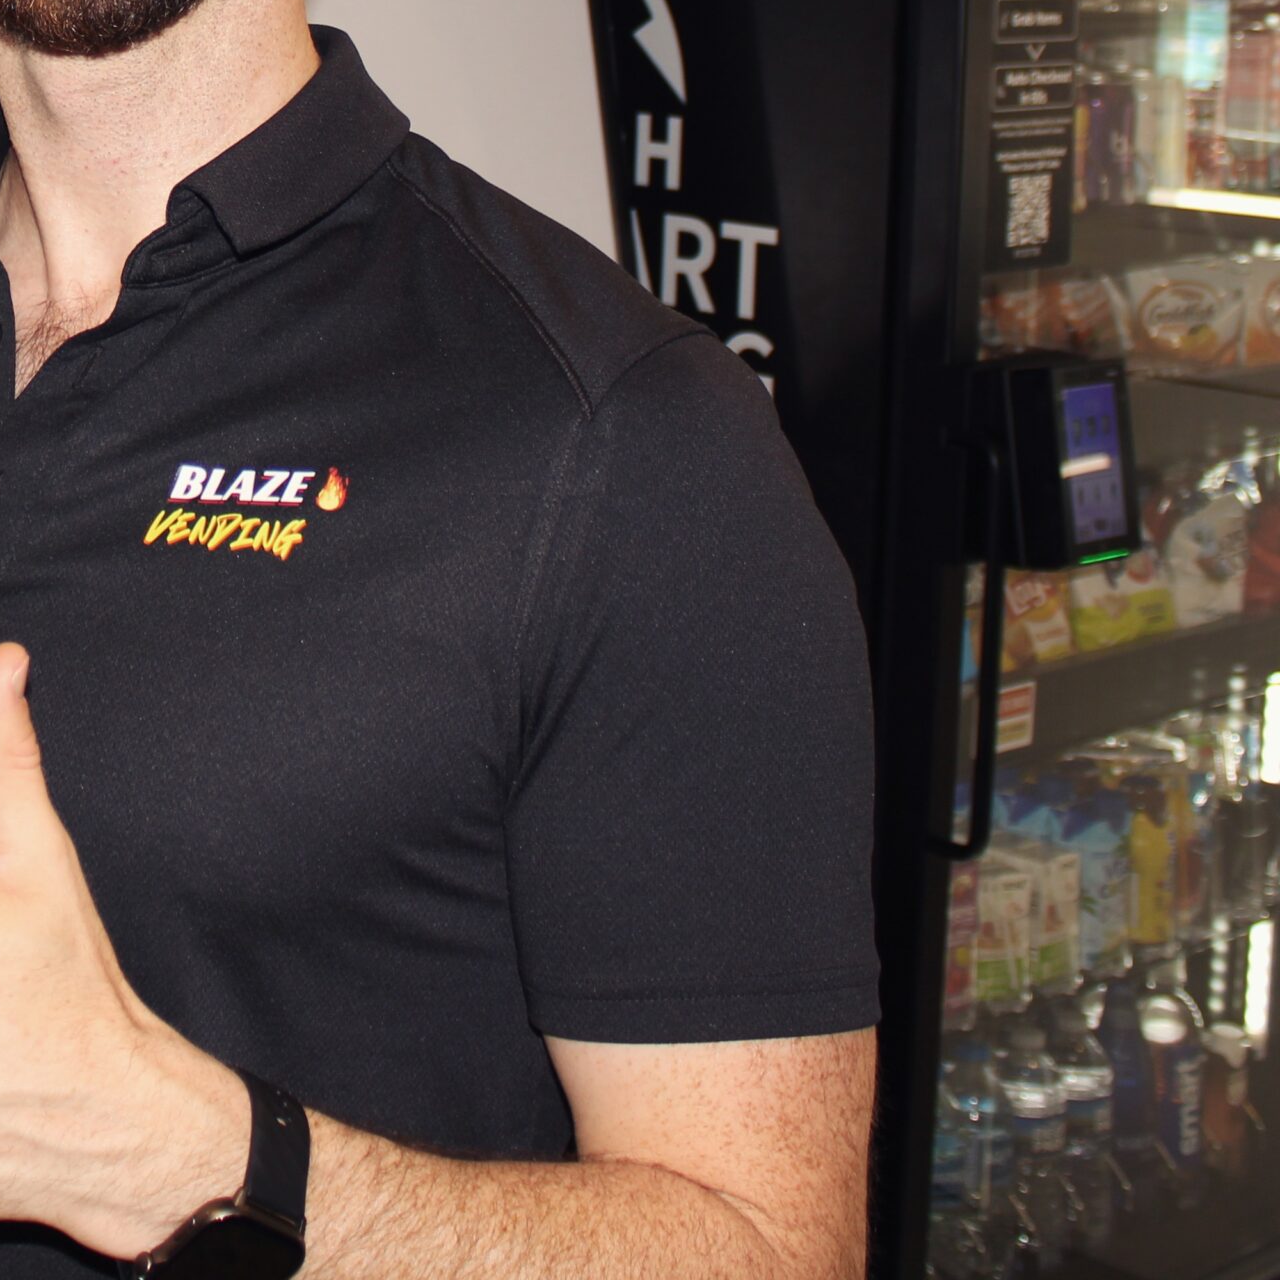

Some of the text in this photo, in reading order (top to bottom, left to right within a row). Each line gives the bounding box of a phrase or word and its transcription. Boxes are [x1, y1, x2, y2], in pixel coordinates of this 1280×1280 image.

[631, 208, 780, 321] RT
[167, 464, 316, 506] BLAZE
[143, 508, 307, 561] VENDING
